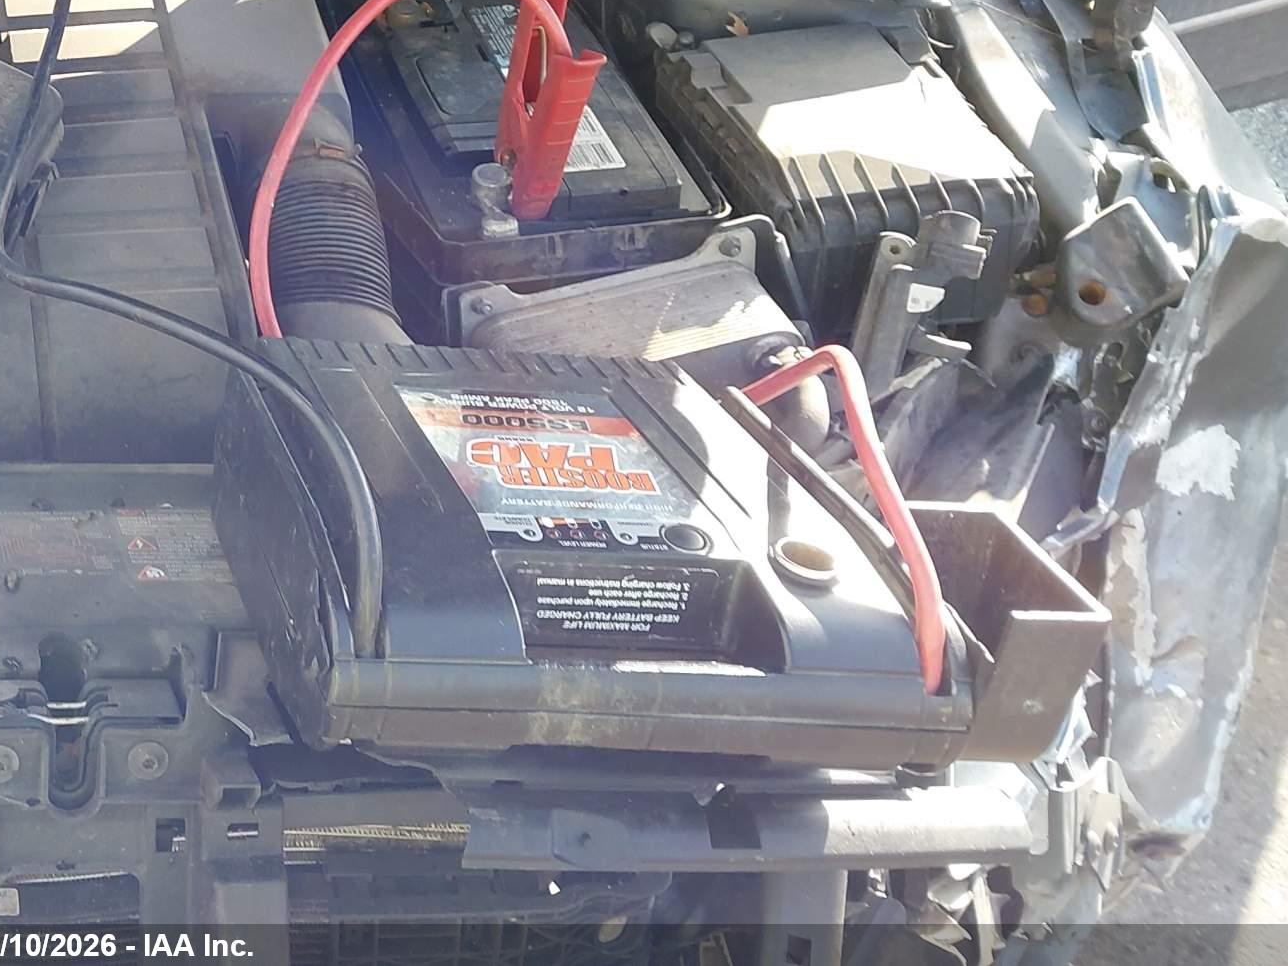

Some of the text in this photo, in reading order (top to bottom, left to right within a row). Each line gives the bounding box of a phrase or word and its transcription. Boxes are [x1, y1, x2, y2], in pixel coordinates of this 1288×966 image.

[484, 400, 536, 410] POWER
[460, 414, 590, 432] ES5000
[470, 442, 615, 471] PAC
[498, 466, 657, 492] BOOSTER
[500, 498, 552, 507] BATTERY
[537, 577, 690, 591] 3. Follow charging instructions in manual
[603, 589, 623, 598] each
[624, 590, 642, 599] after
[643, 590, 679, 600] Recharge
[681, 592, 689, 600] 2.
[537, 596, 686, 610] 1. Recharge immediately upon purchase
[536, 610, 680, 623] KEEP BATTERY FULLY CHARGED
[563, 620, 650, 631] FOR MAXIMUM LIFE
